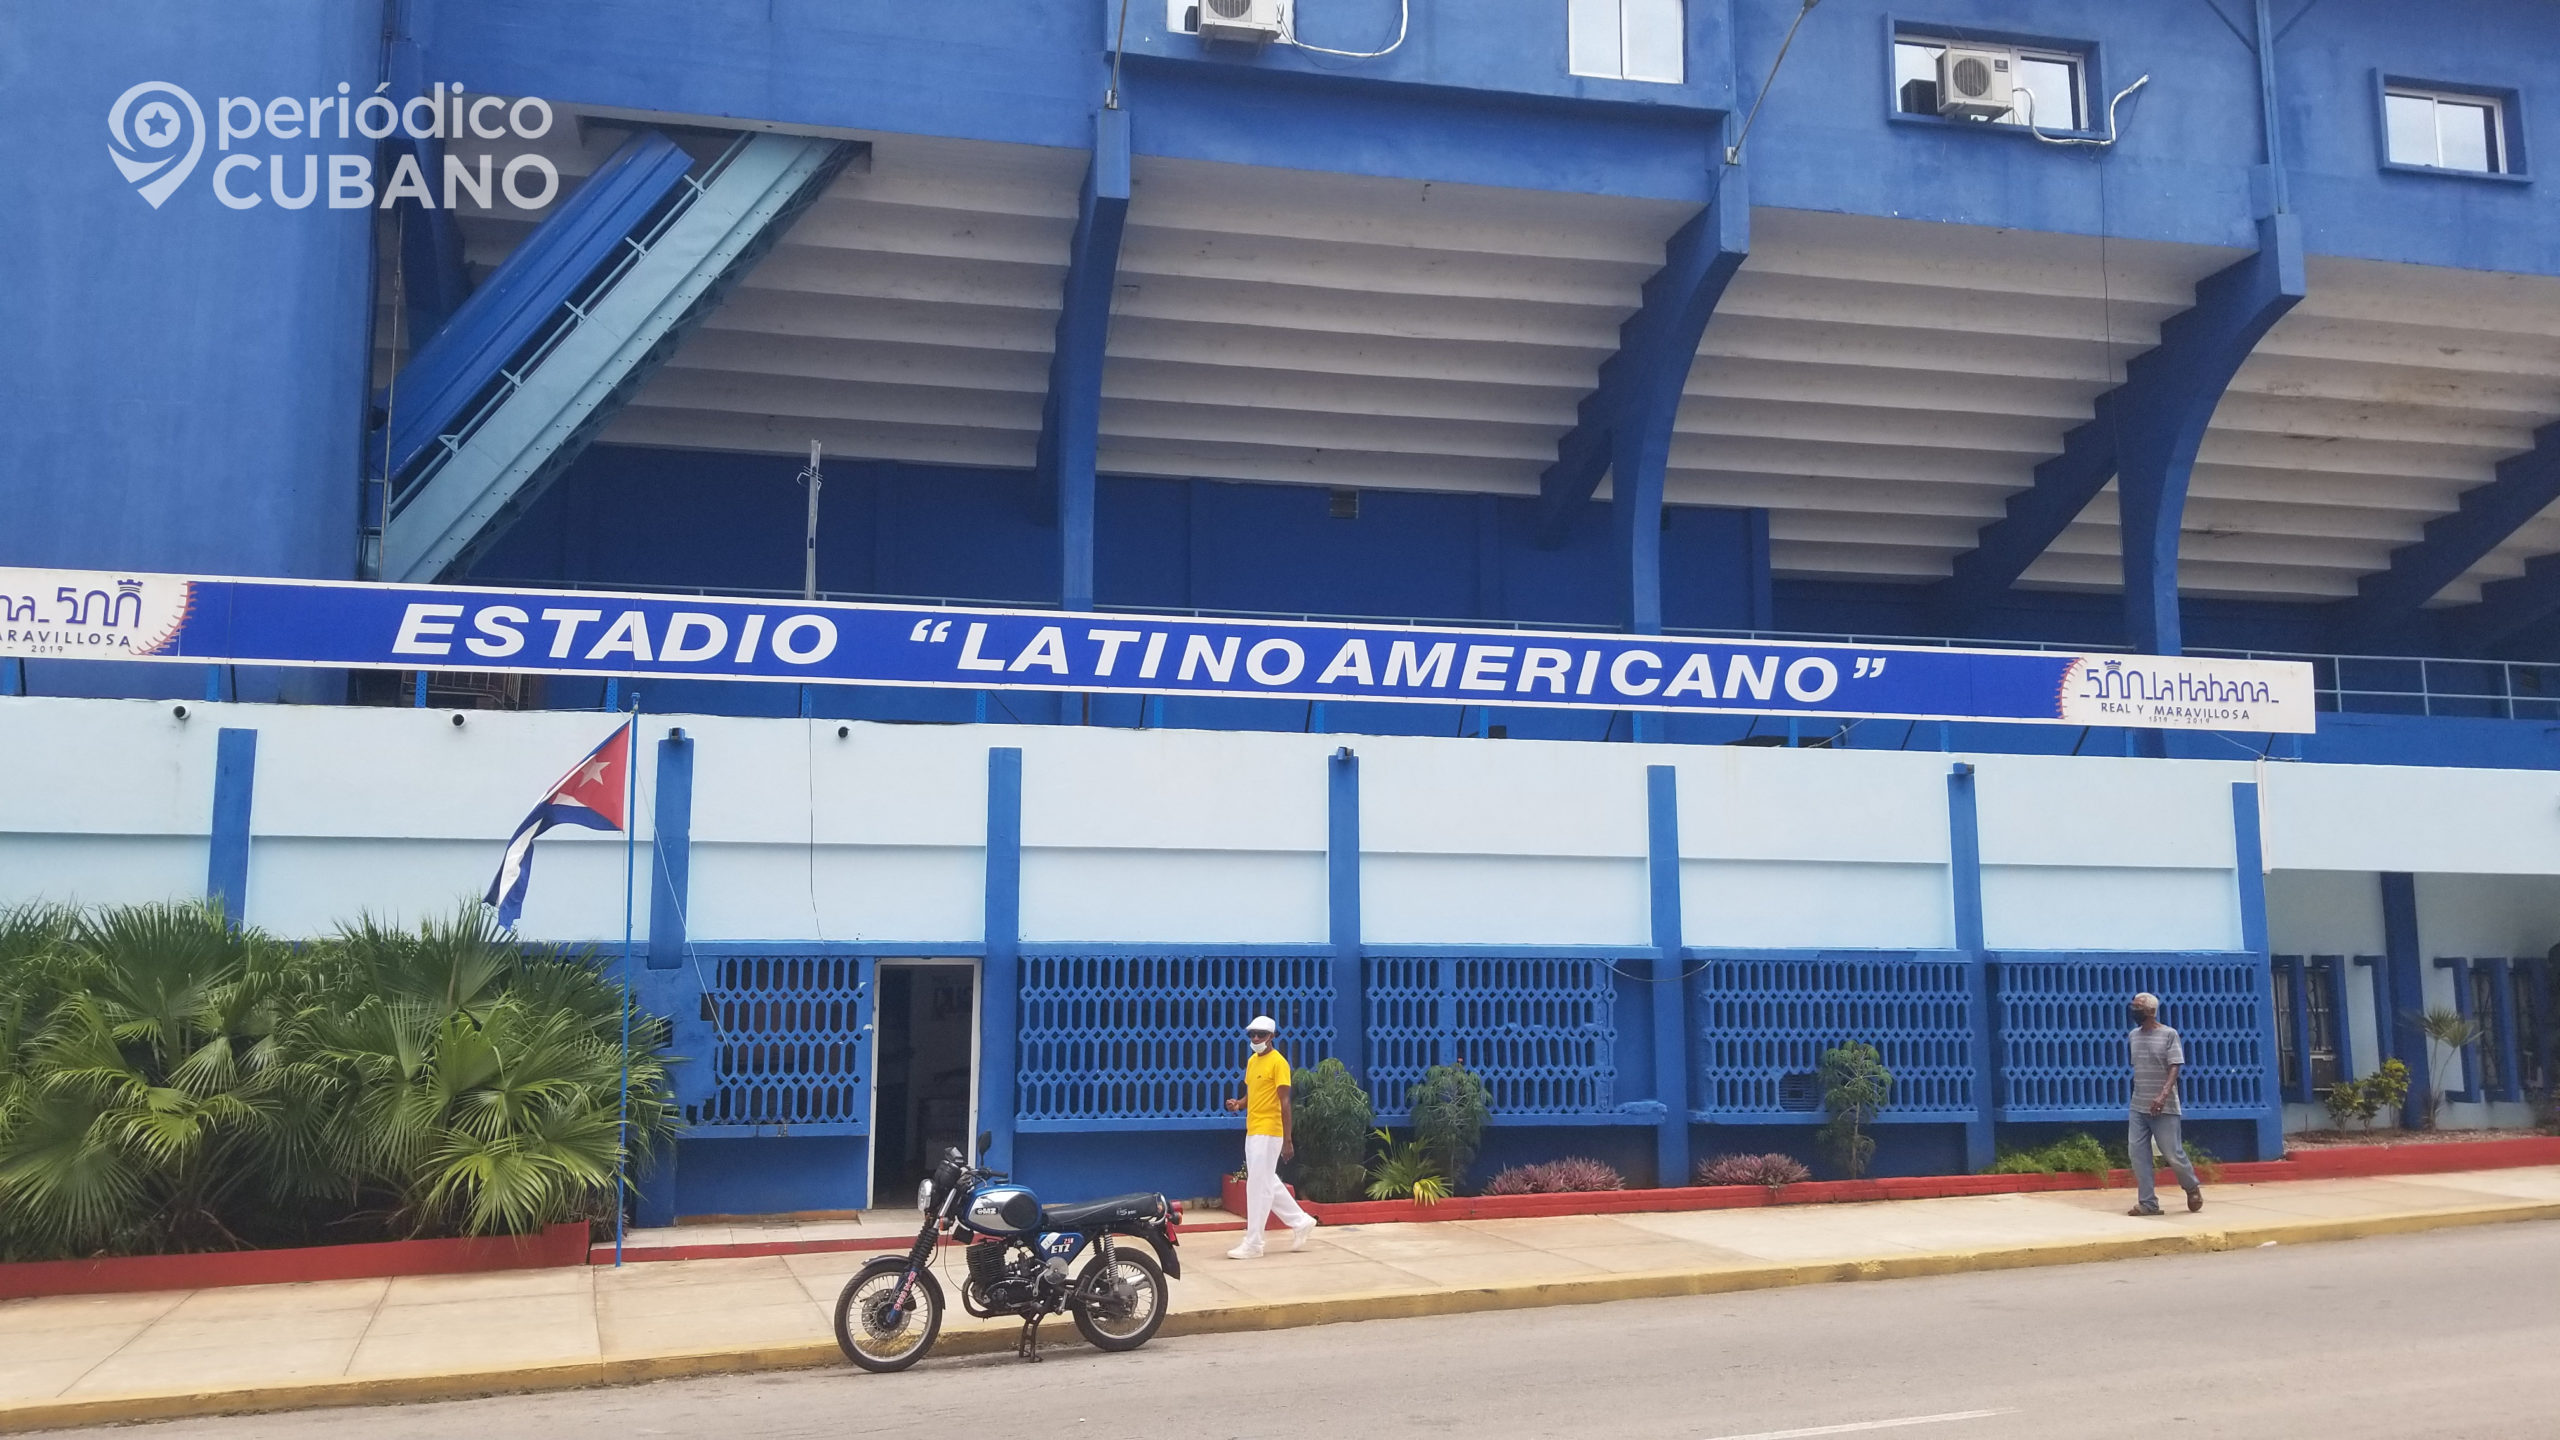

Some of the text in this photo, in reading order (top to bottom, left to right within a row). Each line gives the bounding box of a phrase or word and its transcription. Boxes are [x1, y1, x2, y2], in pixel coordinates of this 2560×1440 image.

[0, 629, 131, 648] RAVILLOSA
[391, 603, 838, 665] ESTADIO
[31, 645, 64, 653] 2019
[2101, 702, 2250, 720] REAL Y MARAVILLOSA
[1050, 1243, 1071, 1254] ETZ
